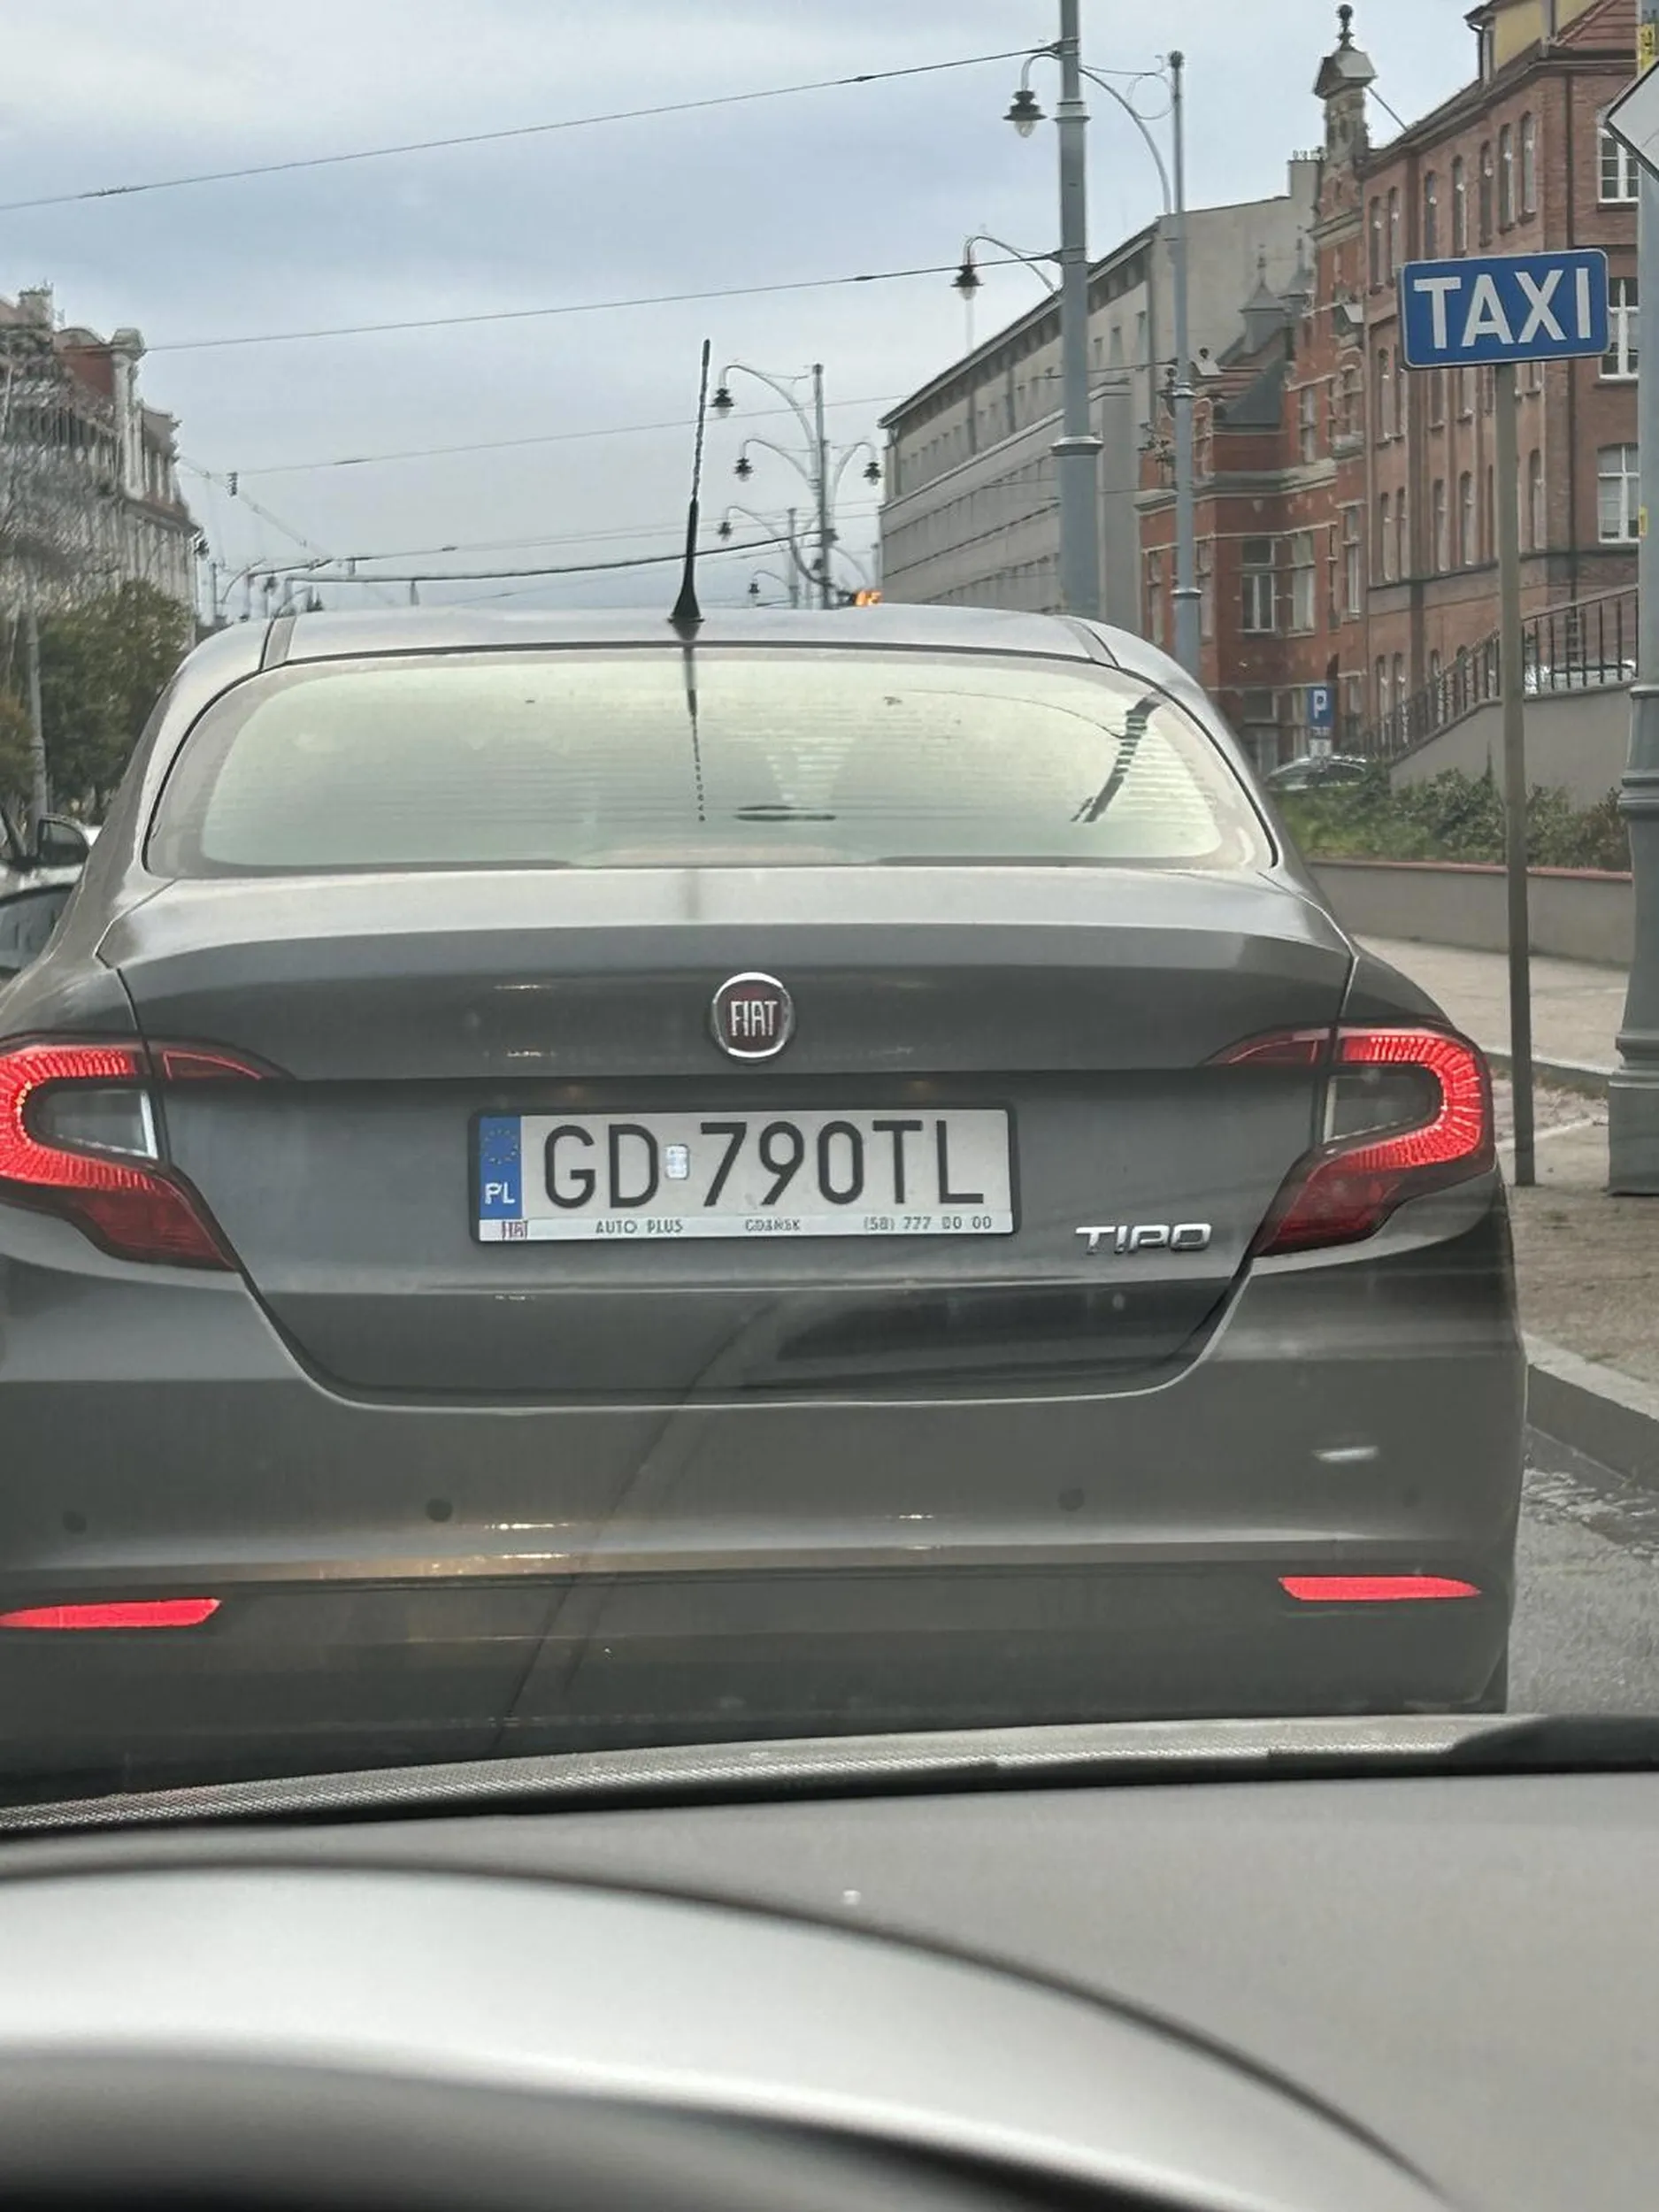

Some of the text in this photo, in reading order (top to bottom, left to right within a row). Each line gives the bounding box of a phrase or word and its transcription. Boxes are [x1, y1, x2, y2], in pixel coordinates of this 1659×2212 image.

[1413, 267, 1592, 349] TAXI
[1313, 690, 1327, 718] P
[730, 1000, 778, 1037] FIAT
[544, 1119, 984, 1209] GD 790TL
[485, 1182, 515, 1204] PL
[595, 1219, 683, 1234] AUTO PLUS
[864, 1216, 895, 1231] (58)
[903, 1216, 932, 1230] 777
[972, 1215, 992, 1229] 00
[1076, 1224, 1211, 1254] TIPO
